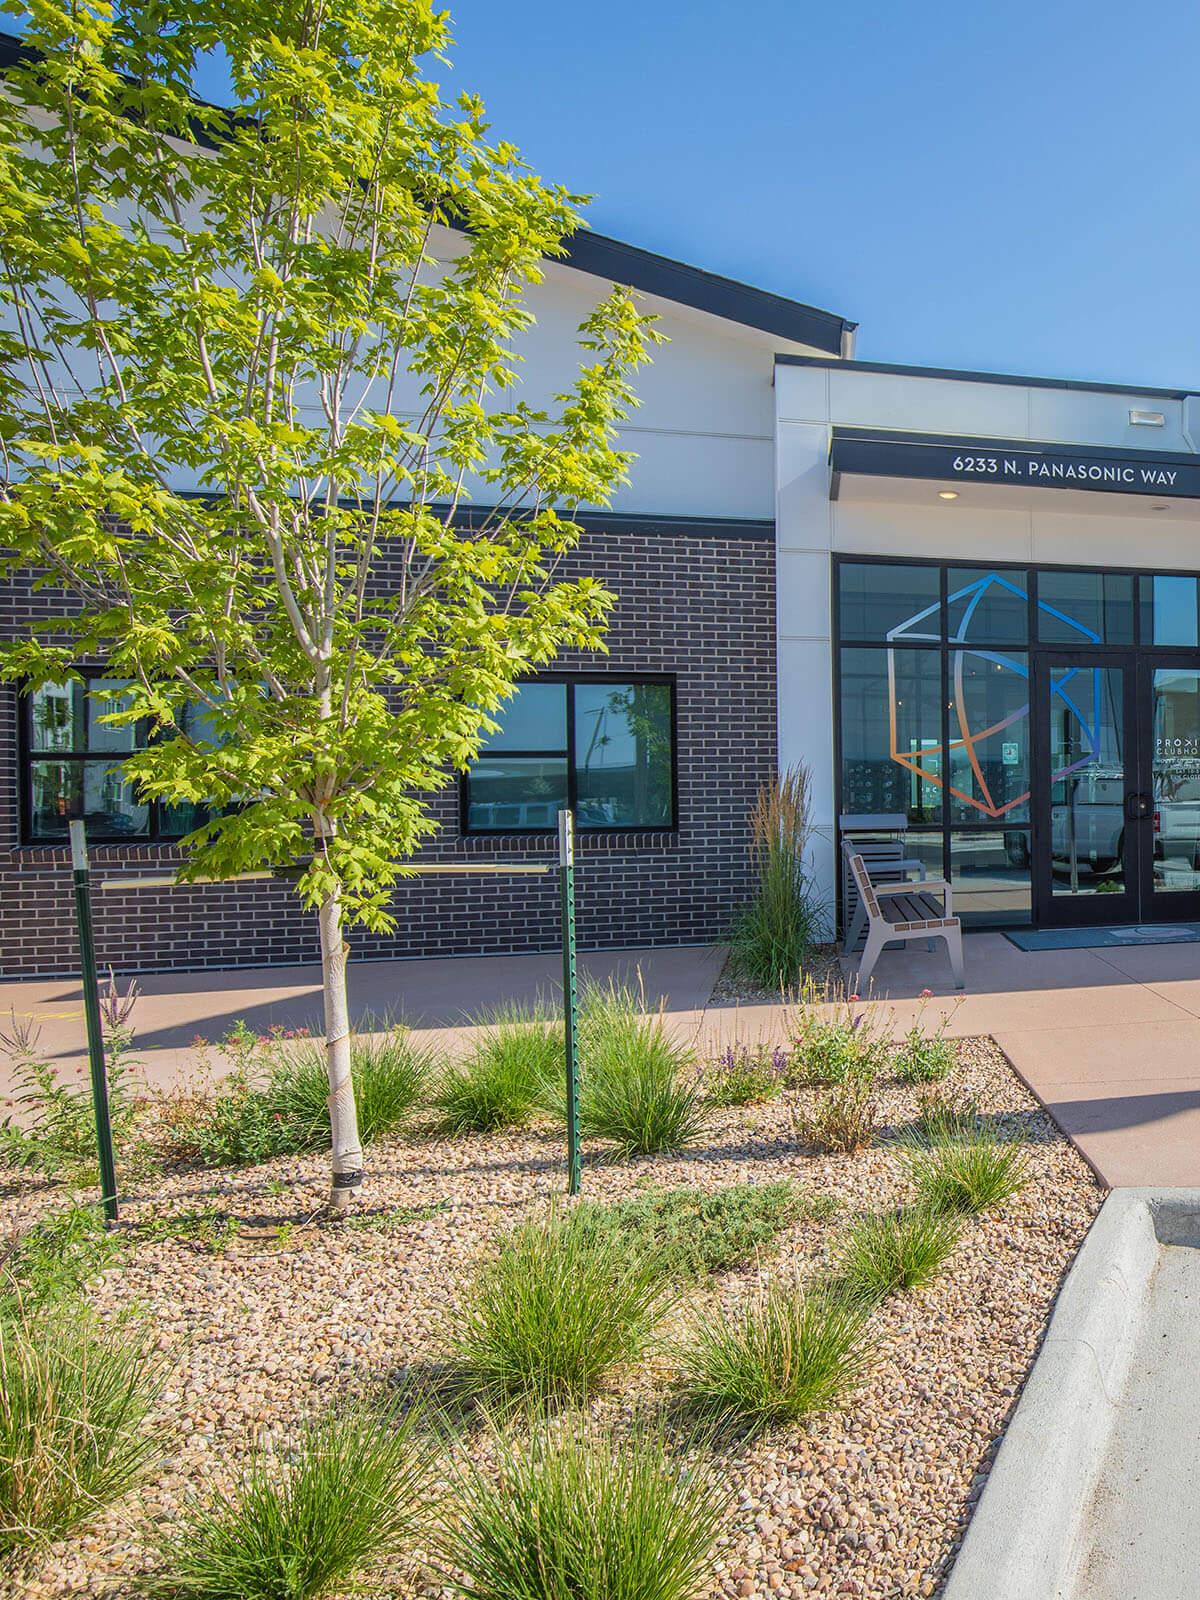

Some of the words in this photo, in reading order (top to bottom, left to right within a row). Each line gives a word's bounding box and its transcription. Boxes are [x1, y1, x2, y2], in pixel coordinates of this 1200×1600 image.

[952, 456, 998, 473] 6233
[1004, 459, 1022, 475] N.
[1028, 461, 1135, 483] PANASONIC
[1141, 469, 1178, 485] WAY
